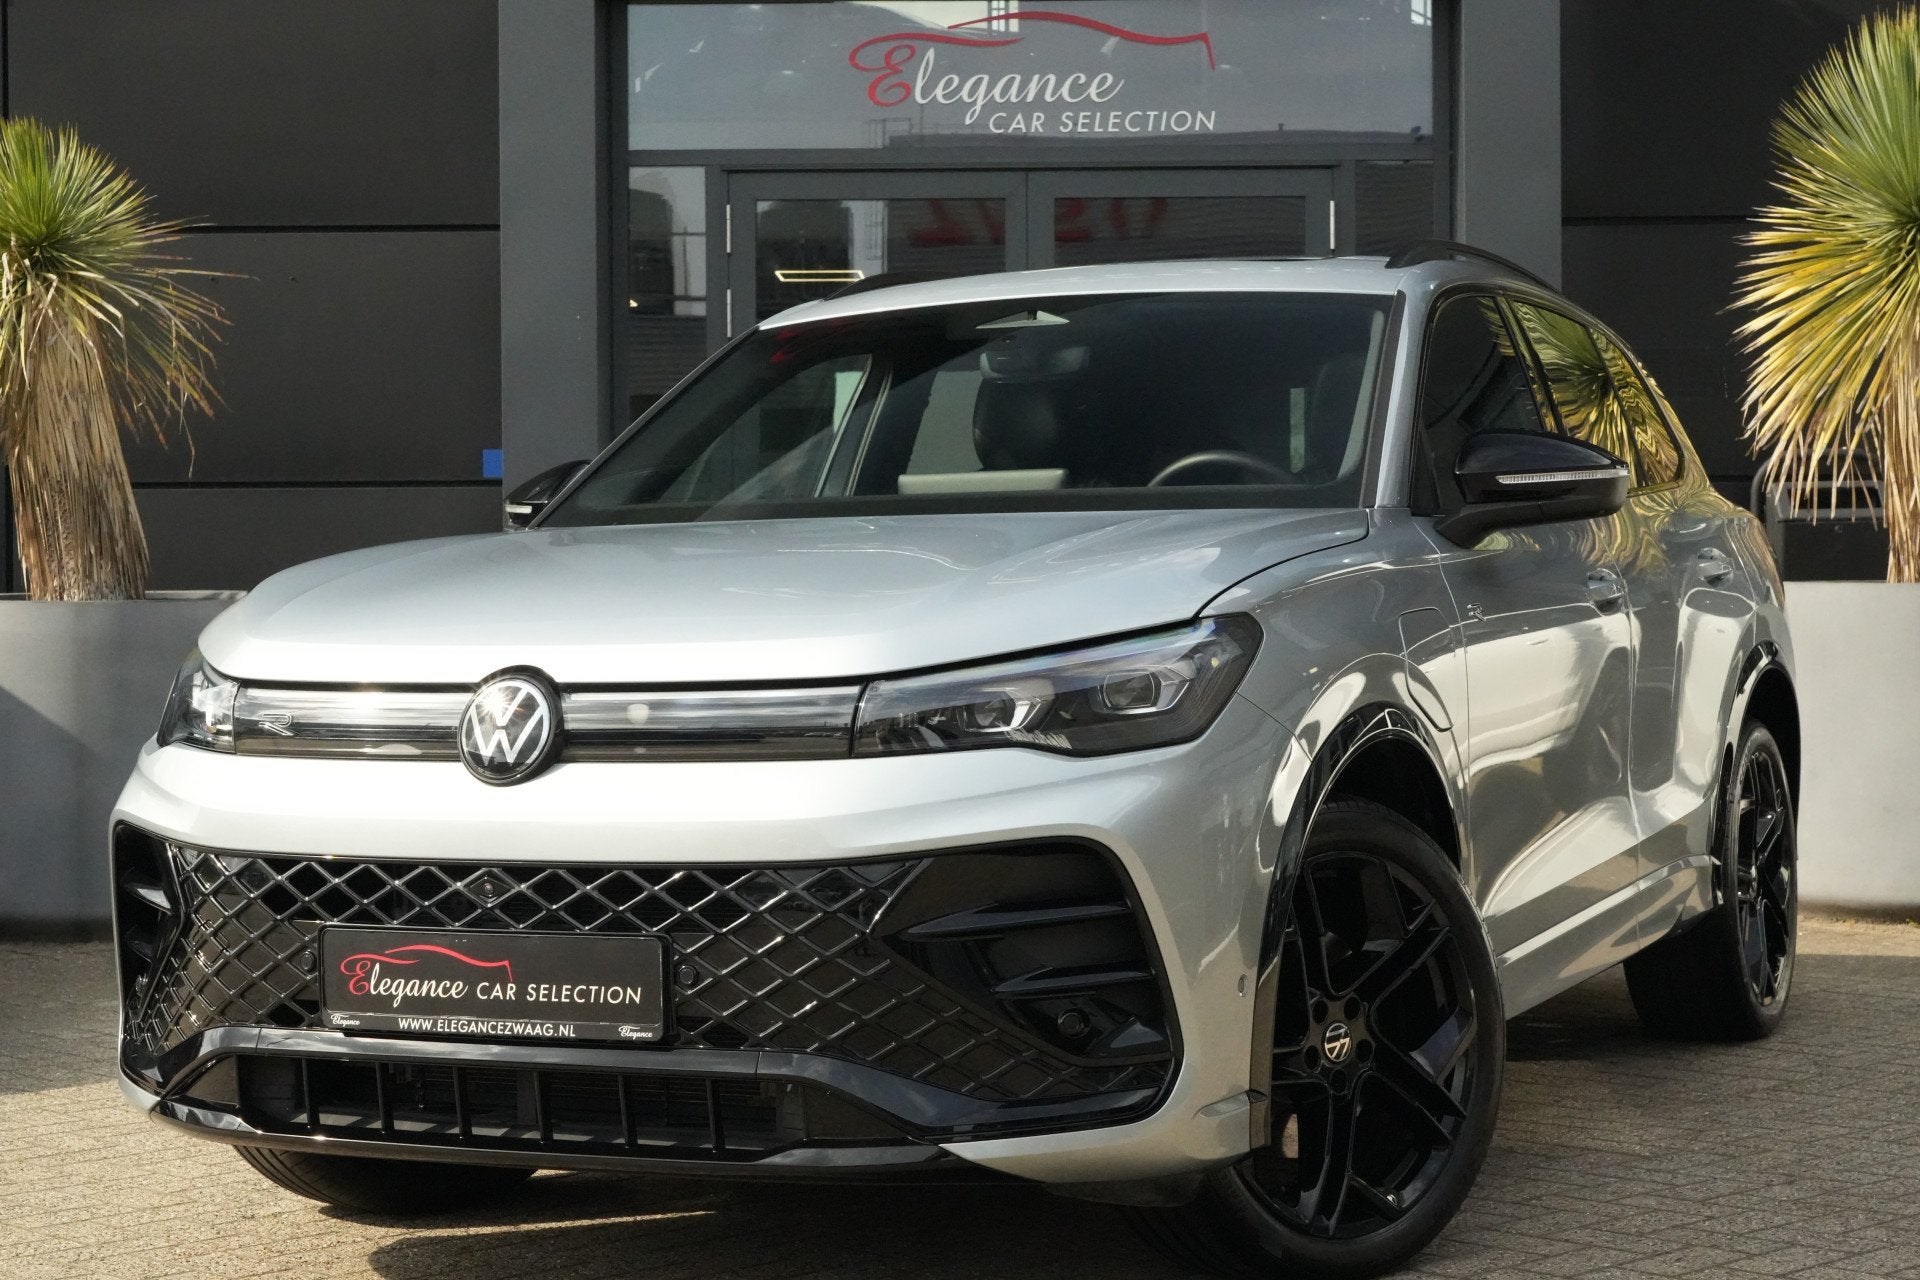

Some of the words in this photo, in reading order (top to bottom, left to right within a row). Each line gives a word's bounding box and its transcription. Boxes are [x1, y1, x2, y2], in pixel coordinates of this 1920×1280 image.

[849, 34, 1124, 125] Elegance
[989, 111, 1045, 133] CAR
[1059, 110, 1217, 133] SELECTION
[340, 954, 468, 1008] Elegance
[476, 982, 517, 1001] CAR
[527, 983, 642, 1004] SELECTION
[331, 1014, 360, 1028] Elegance
[399, 1017, 576, 1038] WWW.ELEGANCEZWAAG.NL
[618, 1025, 653, 1040] Elegance
